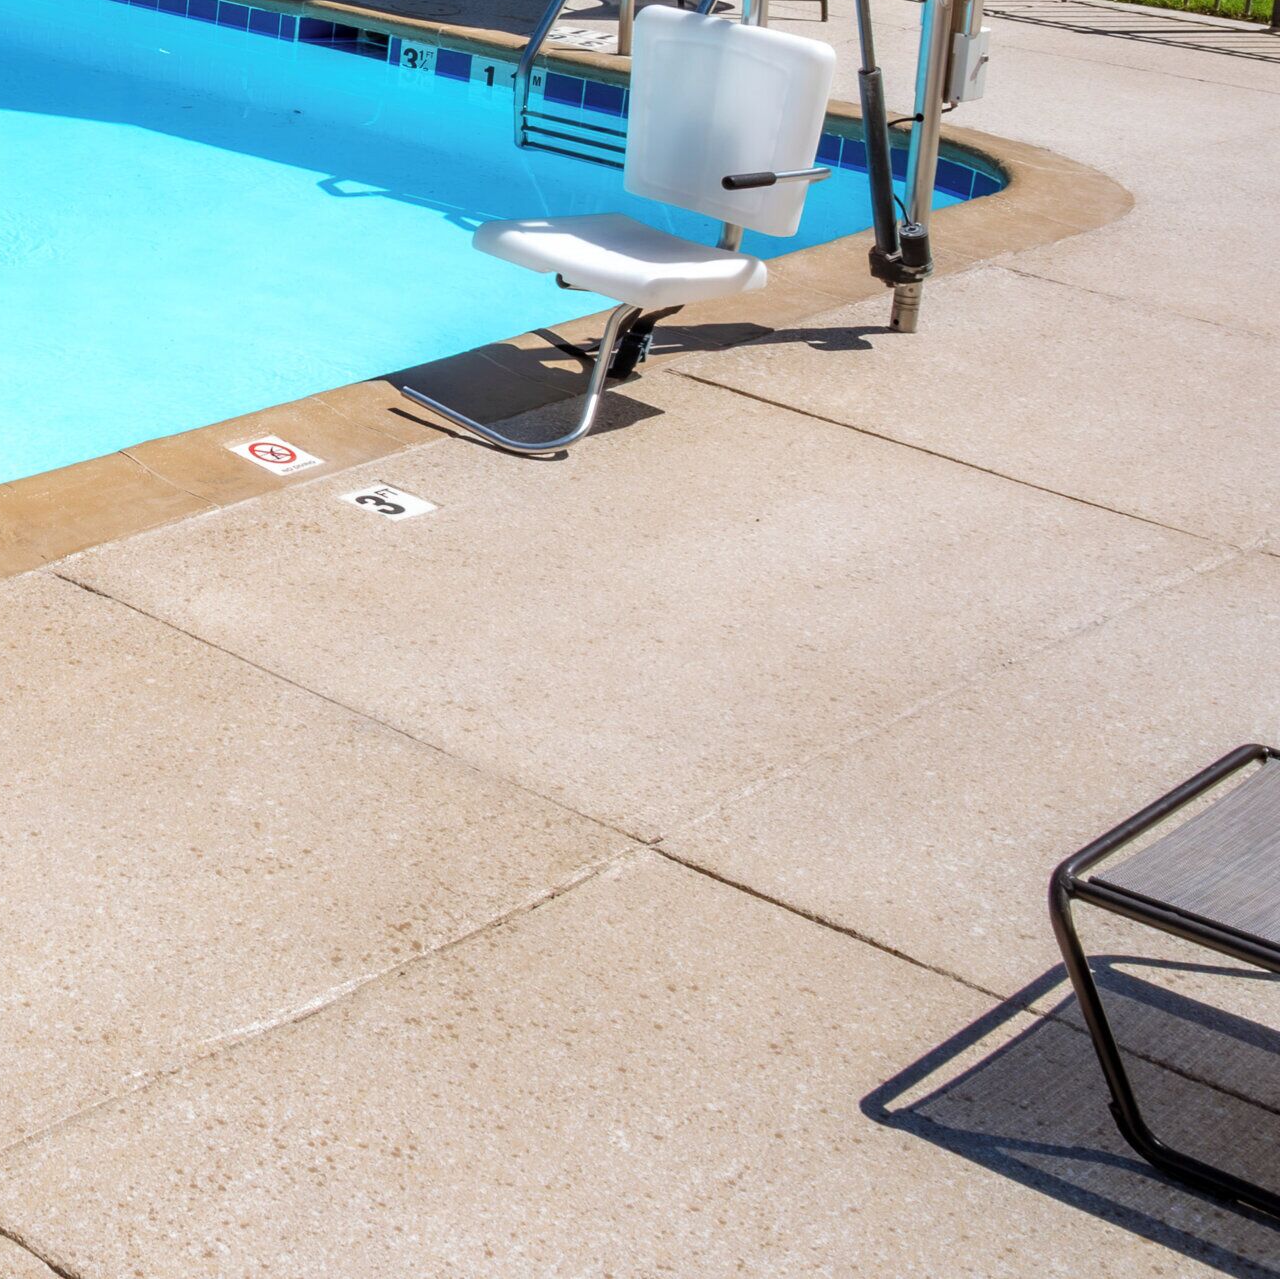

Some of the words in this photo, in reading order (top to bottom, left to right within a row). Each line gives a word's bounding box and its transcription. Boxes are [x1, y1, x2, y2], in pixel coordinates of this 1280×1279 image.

[532, 75, 542, 87] M
[374, 488, 398, 499] FT
[355, 495, 406, 515] 3
